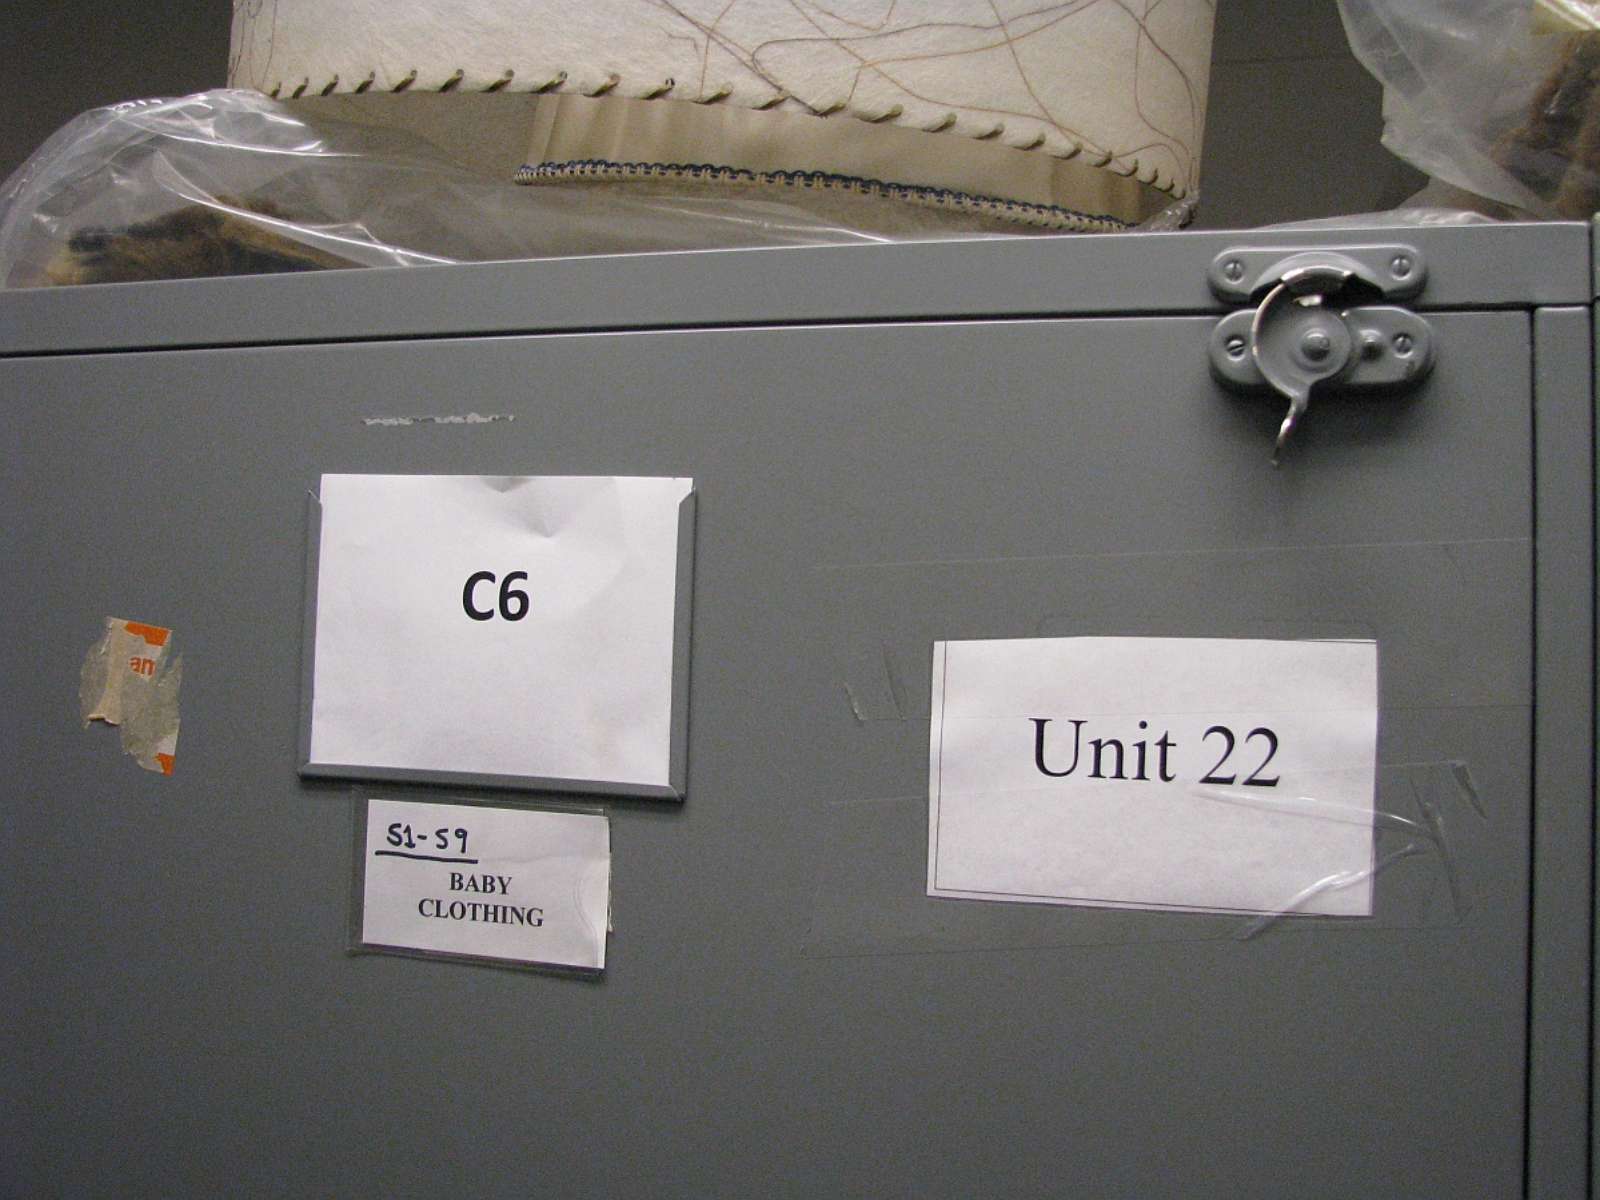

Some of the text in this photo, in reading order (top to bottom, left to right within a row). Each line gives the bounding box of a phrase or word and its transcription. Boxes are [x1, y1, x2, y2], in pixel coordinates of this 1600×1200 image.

[462, 570, 529, 622] C6
[1029, 717, 1280, 787] Unit 22
[449, 872, 513, 895] BABY
[417, 898, 544, 927] CLOTHING
